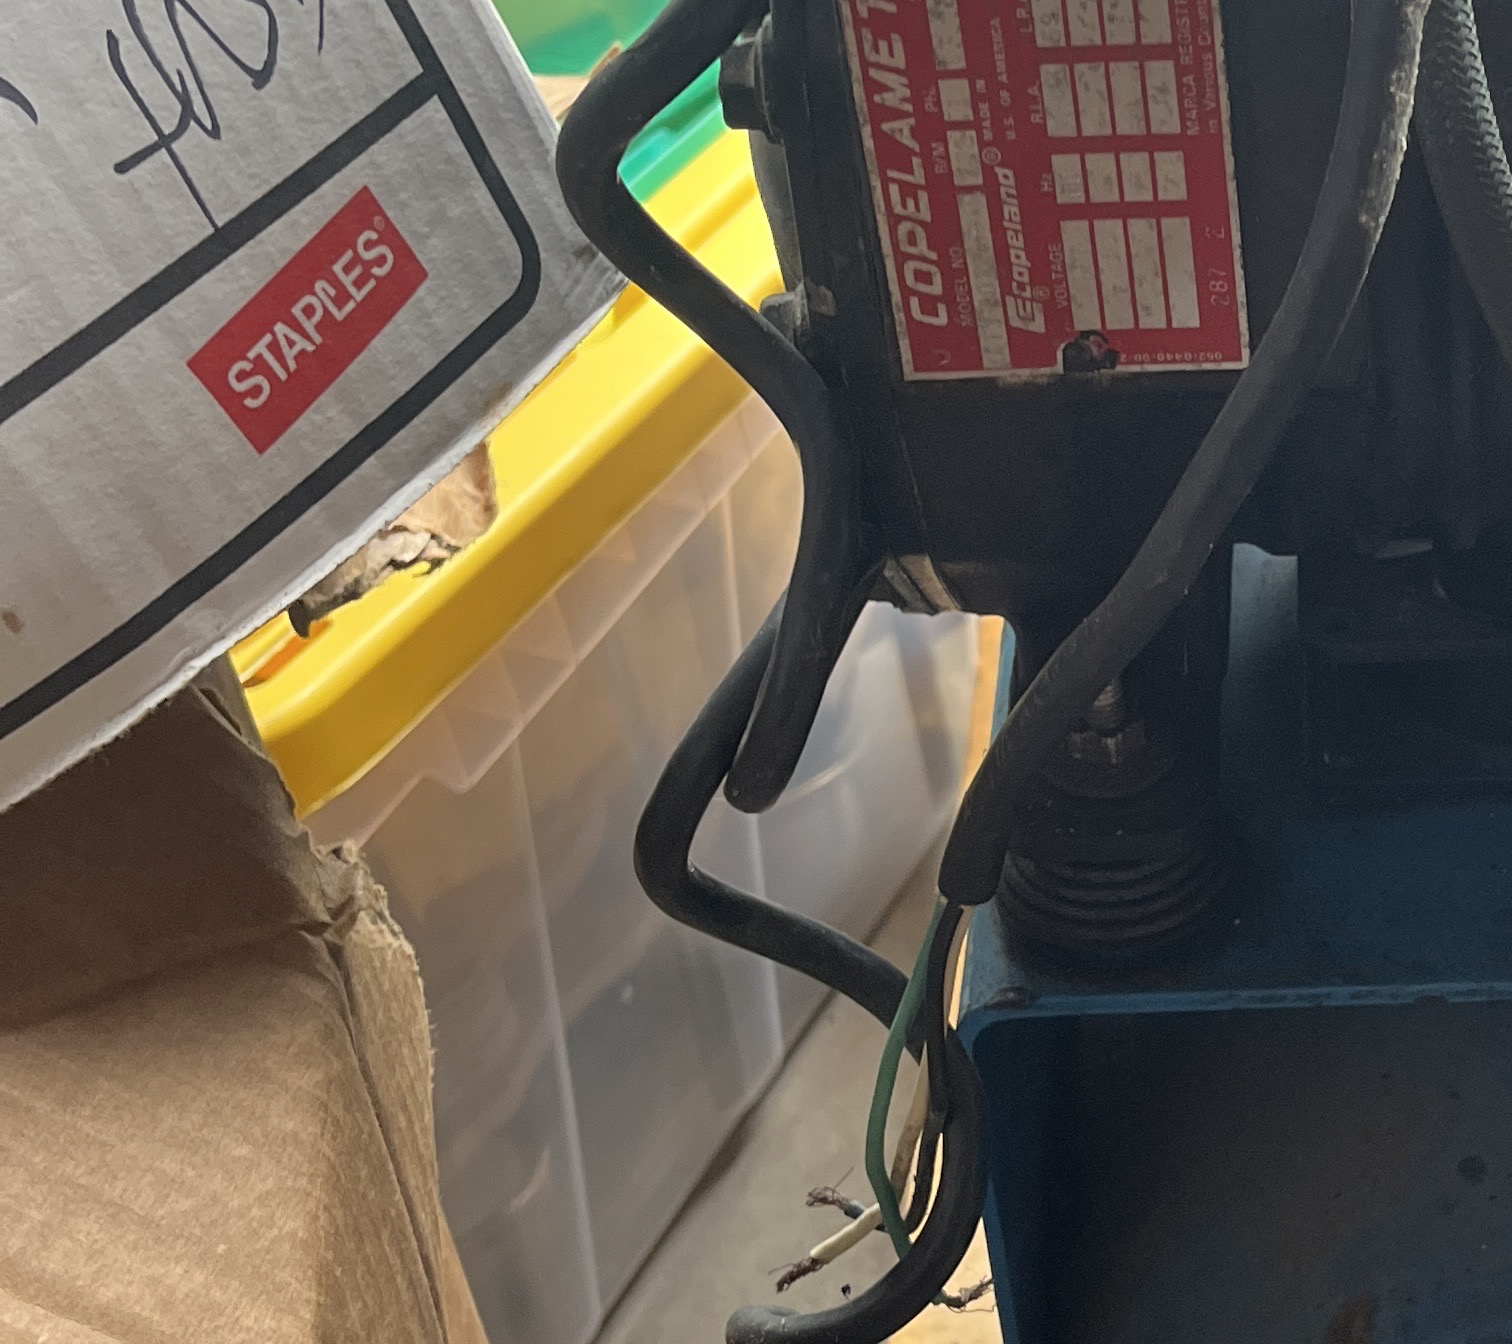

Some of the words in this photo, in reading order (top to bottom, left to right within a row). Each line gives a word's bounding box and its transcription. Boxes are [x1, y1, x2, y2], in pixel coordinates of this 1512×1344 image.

[989, 17, 1009, 83] AMERICA
[998, 87, 1012, 106] OF
[1181, 74, 1201, 134] MARCA
[1200, 52, 1216, 110] Various
[978, 101, 994, 140] MADE
[1039, 173, 1052, 191] Hz
[954, 274, 972, 325] MODEL
[1048, 243, 1068, 308] VOLTAGE
[226, 227, 396, 411] STAPLES
